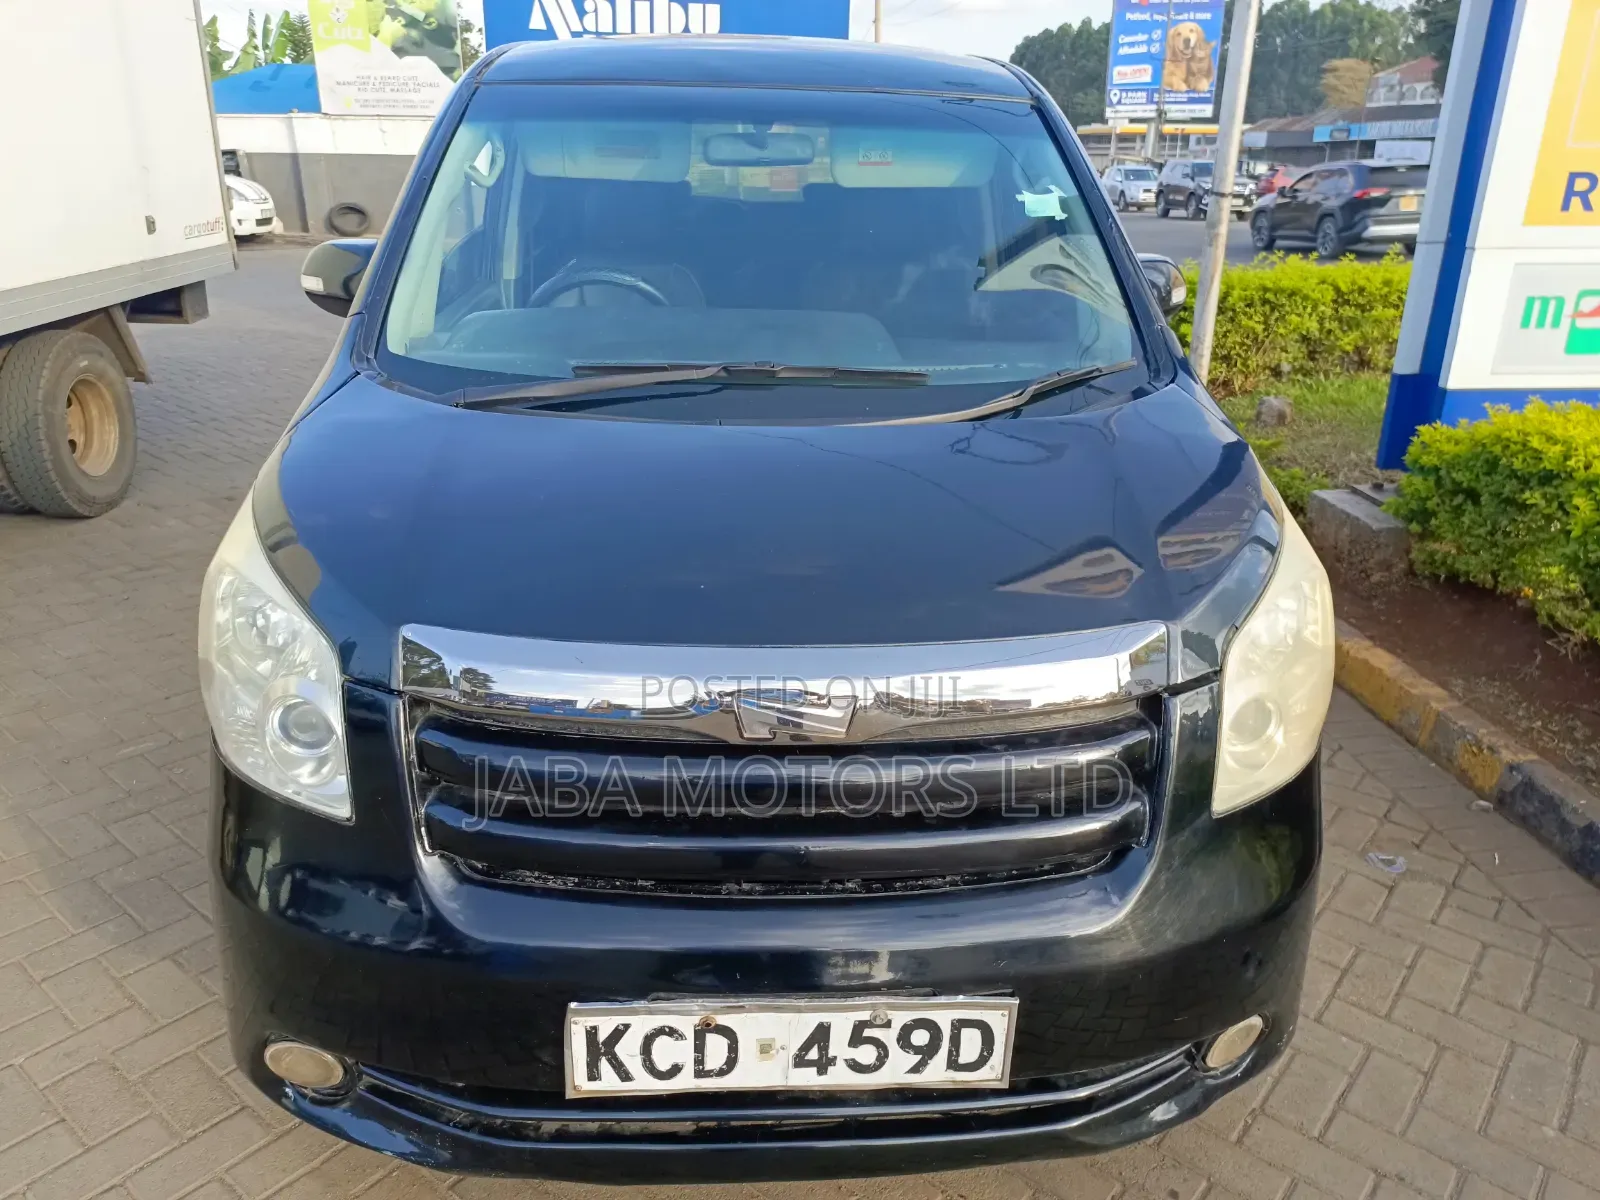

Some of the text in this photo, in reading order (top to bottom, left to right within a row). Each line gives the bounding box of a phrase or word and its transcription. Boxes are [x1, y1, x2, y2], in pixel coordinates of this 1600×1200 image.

[529, 0, 721, 39] Malibu
[585, 1017, 996, 1083] KCD 459D
